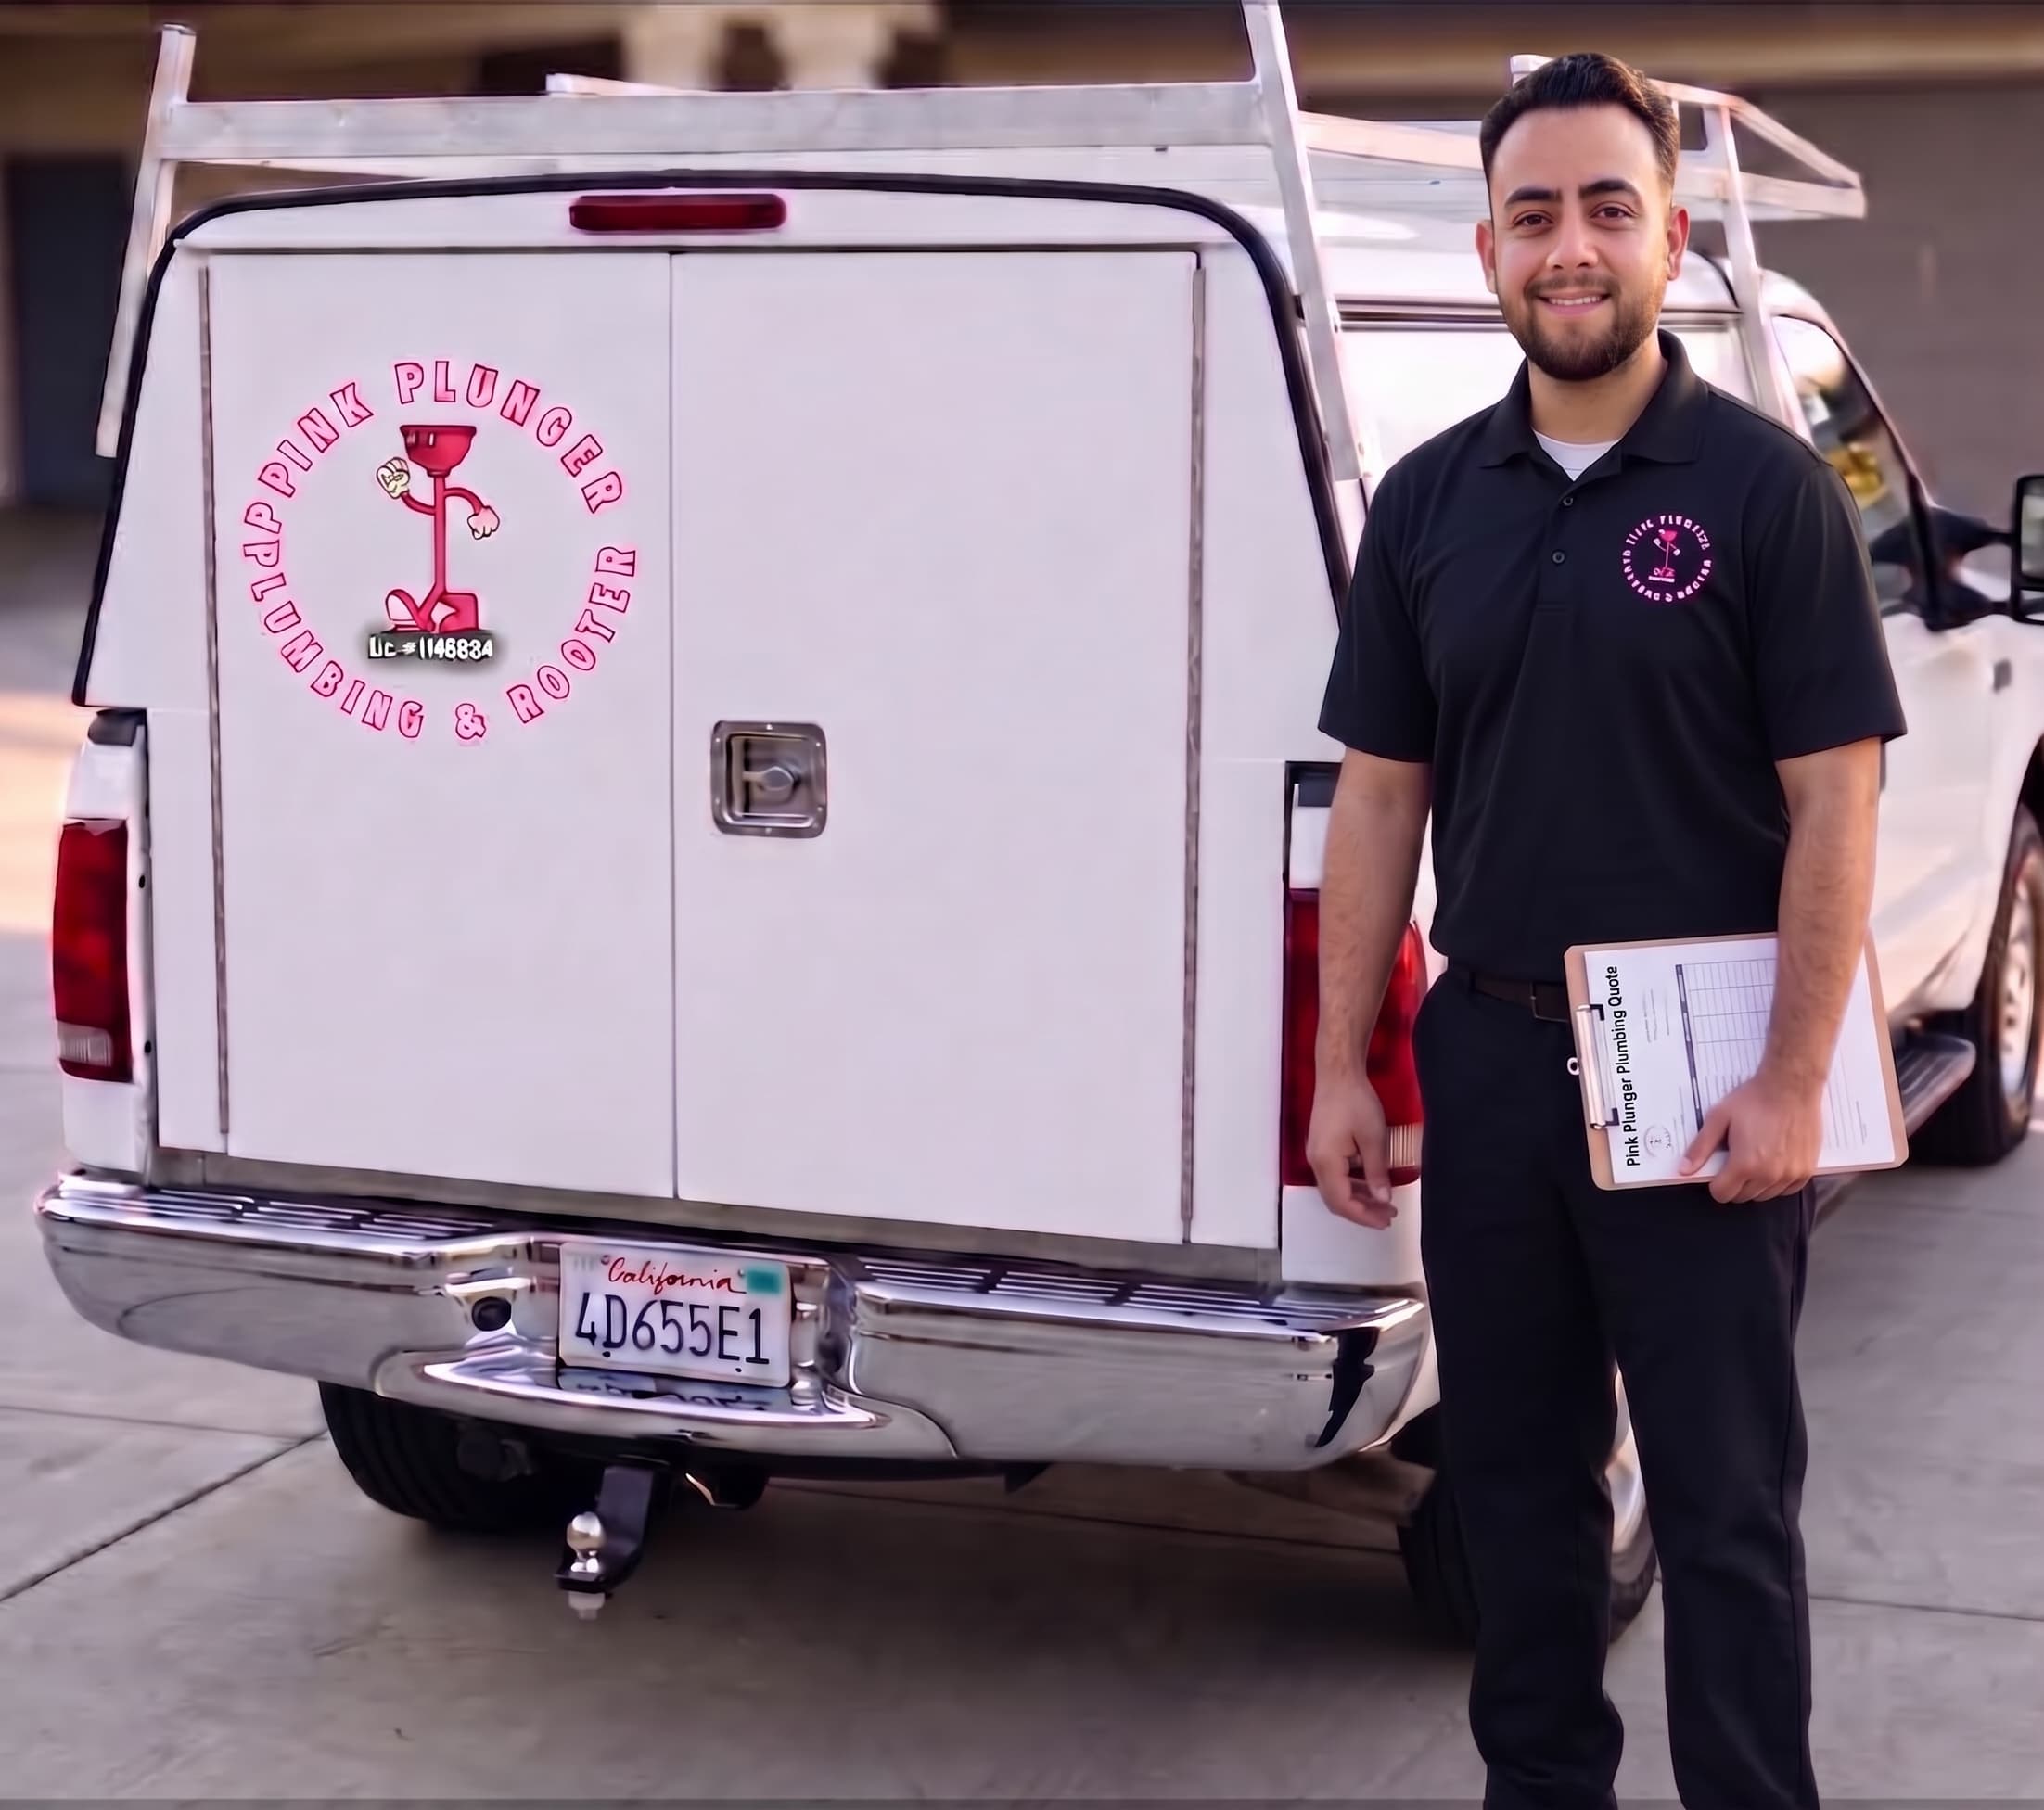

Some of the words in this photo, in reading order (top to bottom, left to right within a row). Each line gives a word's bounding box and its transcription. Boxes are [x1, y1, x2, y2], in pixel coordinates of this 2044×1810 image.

[395, 361, 622, 513] PLUNGER
[455, 703, 486, 739] &
[506, 546, 636, 723] ROOTER
[1605, 966, 1623, 1007] Quote
[1611, 1010, 1630, 1074] Plumbing
[1621, 1077, 1638, 1132] Plunger
[1625, 1136, 1641, 1166] Pink
[608, 1257, 747, 1295] California
[575, 1292, 769, 1365] 4D655E1
